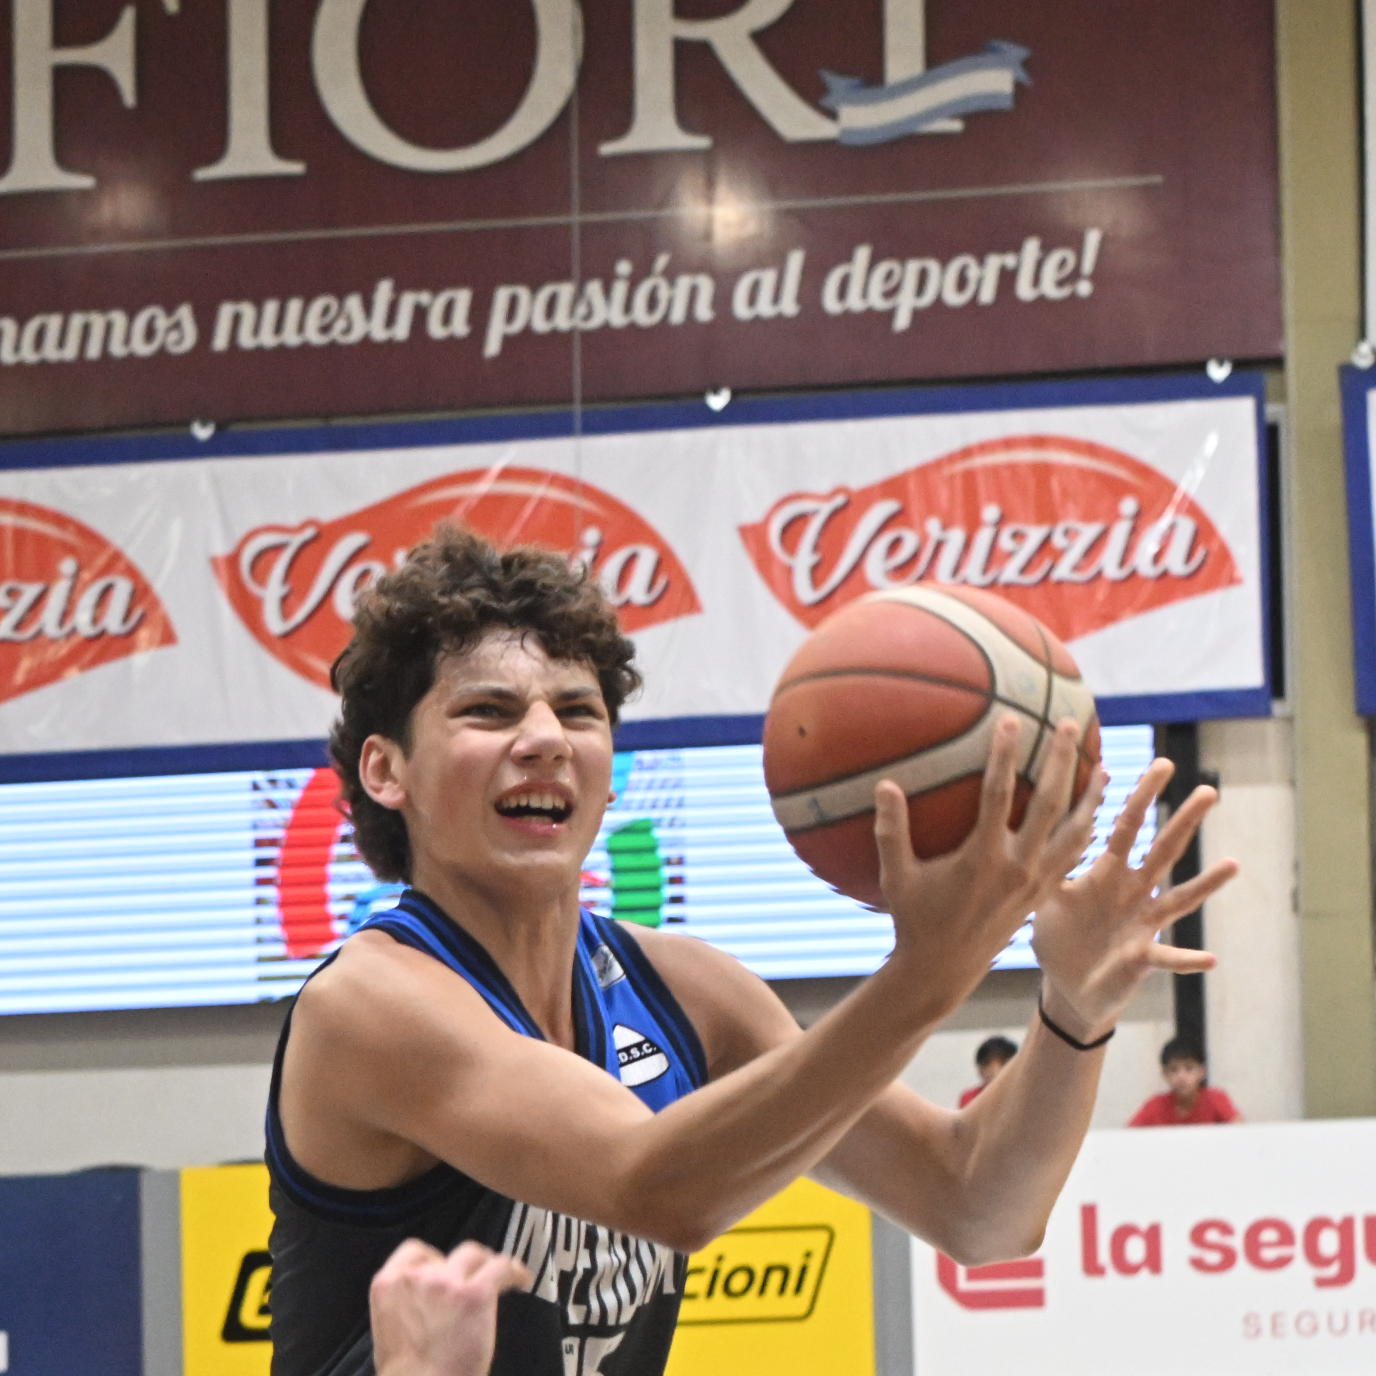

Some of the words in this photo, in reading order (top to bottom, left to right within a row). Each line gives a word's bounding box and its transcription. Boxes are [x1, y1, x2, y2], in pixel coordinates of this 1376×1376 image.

[212, 278, 469, 353] nuestra
[484, 253, 714, 358] pasión
[732, 248, 804, 320] al
[824, 229, 1103, 333] deporte!
[239, 525, 670, 638] Veia
[768, 492, 1207, 606] Verizzia
[1080, 1203, 1163, 1278] la
